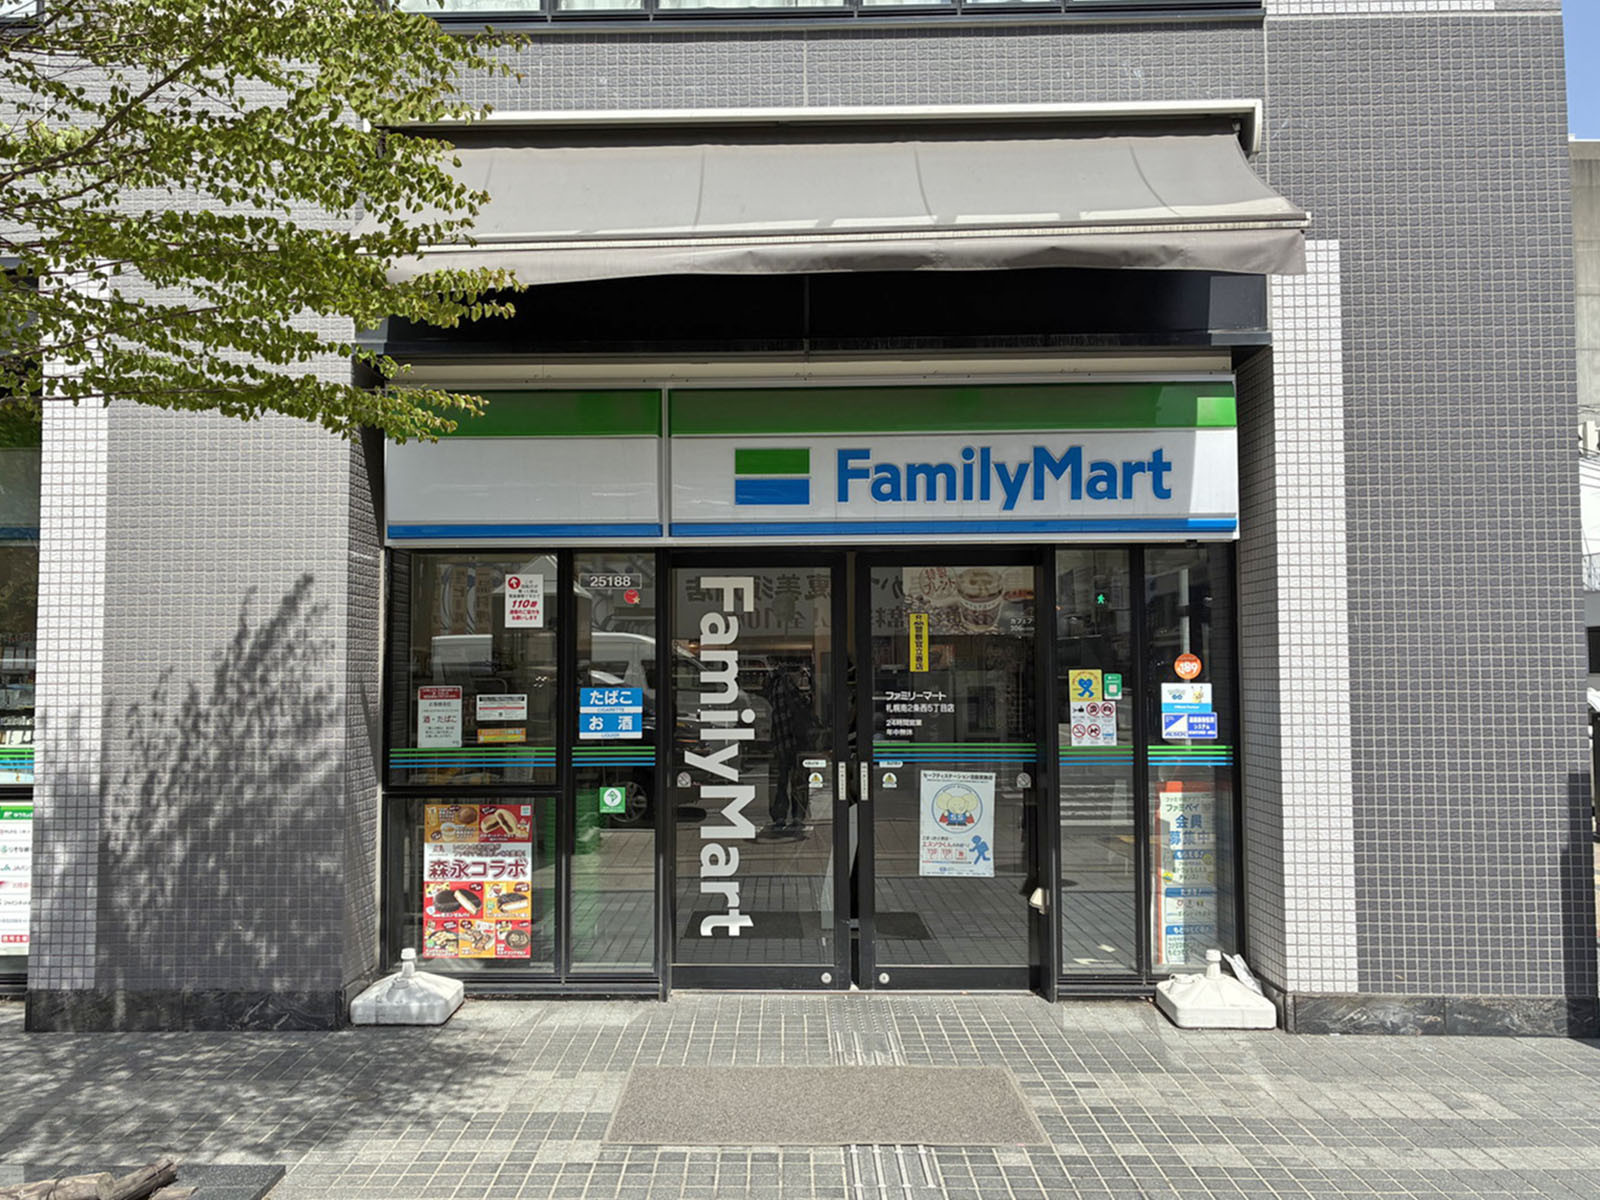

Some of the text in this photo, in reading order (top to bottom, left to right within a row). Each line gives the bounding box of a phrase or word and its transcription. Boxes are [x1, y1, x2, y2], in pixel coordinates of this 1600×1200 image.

[837, 446, 1172, 511] FamilyMart
[590, 576, 631, 587] 25188
[512, 600, 538, 608] 110番
[590, 690, 633, 705] たばこ
[885, 691, 947, 701] ファミリーマート
[886, 728, 914, 736] 年中無休
[684, 576, 756, 936] FamilyMart
[1166, 803, 1200, 812] ファミペイ
[1175, 814, 1202, 828] 会員
[1169, 830, 1210, 845] 募集中
[429, 858, 528, 878] 森永コラボ
